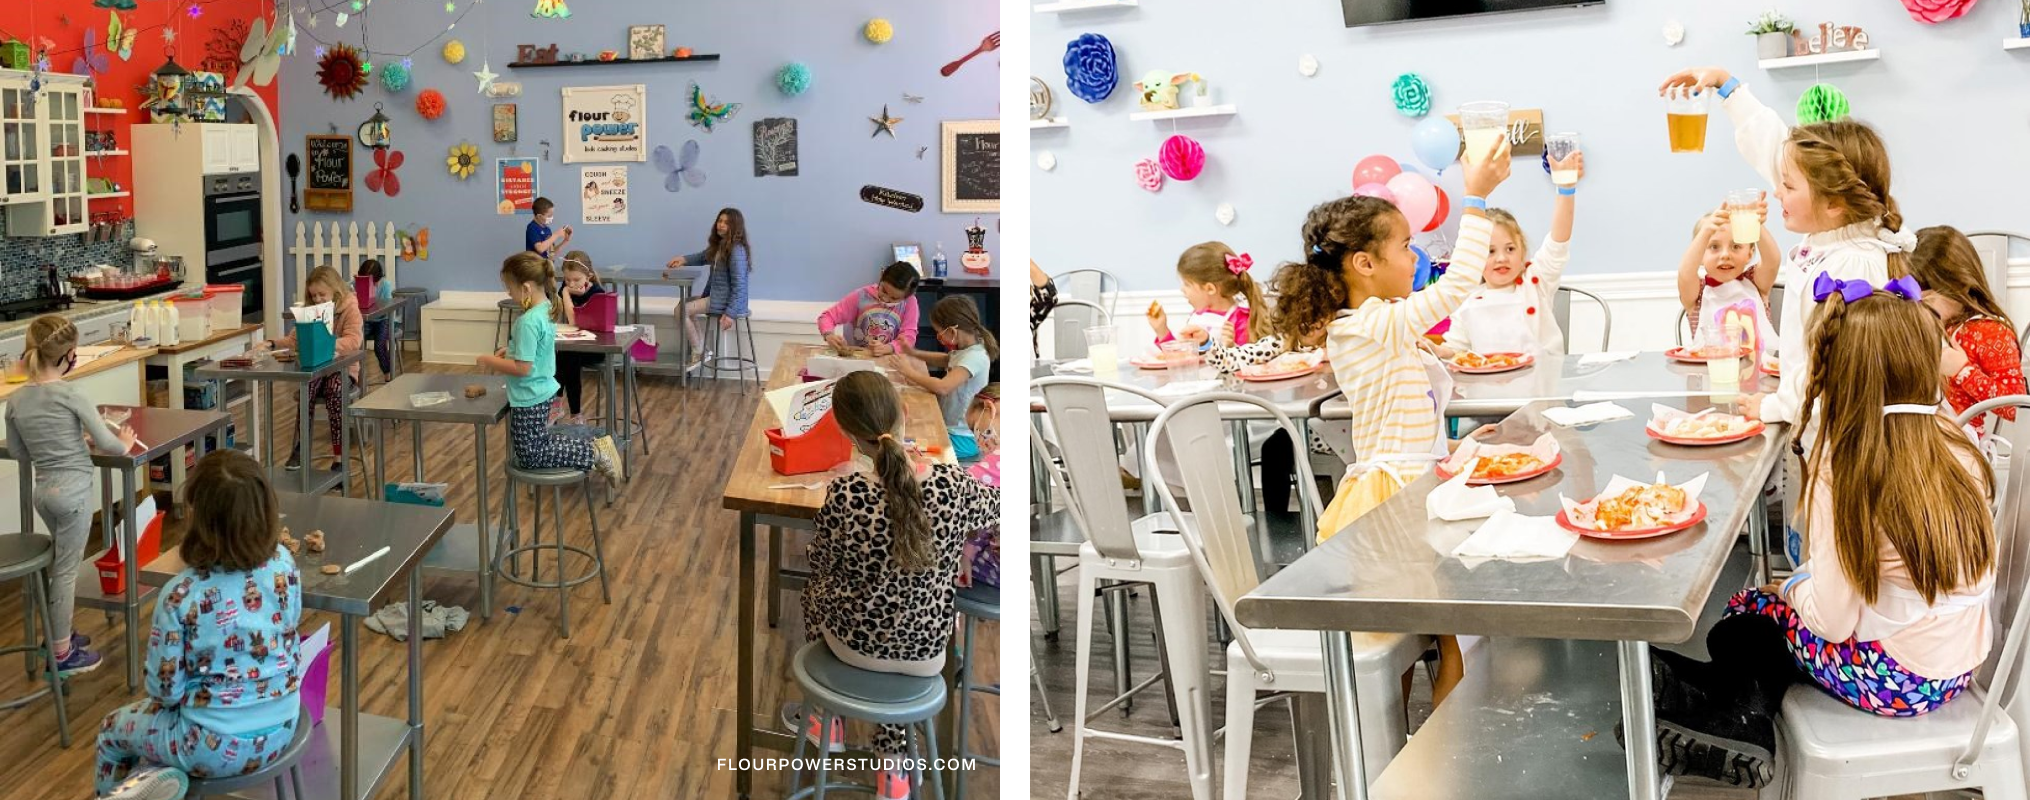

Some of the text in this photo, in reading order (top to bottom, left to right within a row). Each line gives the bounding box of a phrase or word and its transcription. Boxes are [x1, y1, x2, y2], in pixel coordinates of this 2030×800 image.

[1792, 21, 1869, 56] believe
[517, 44, 559, 64] Eat
[569, 110, 610, 122] flour
[581, 122, 639, 142] power
